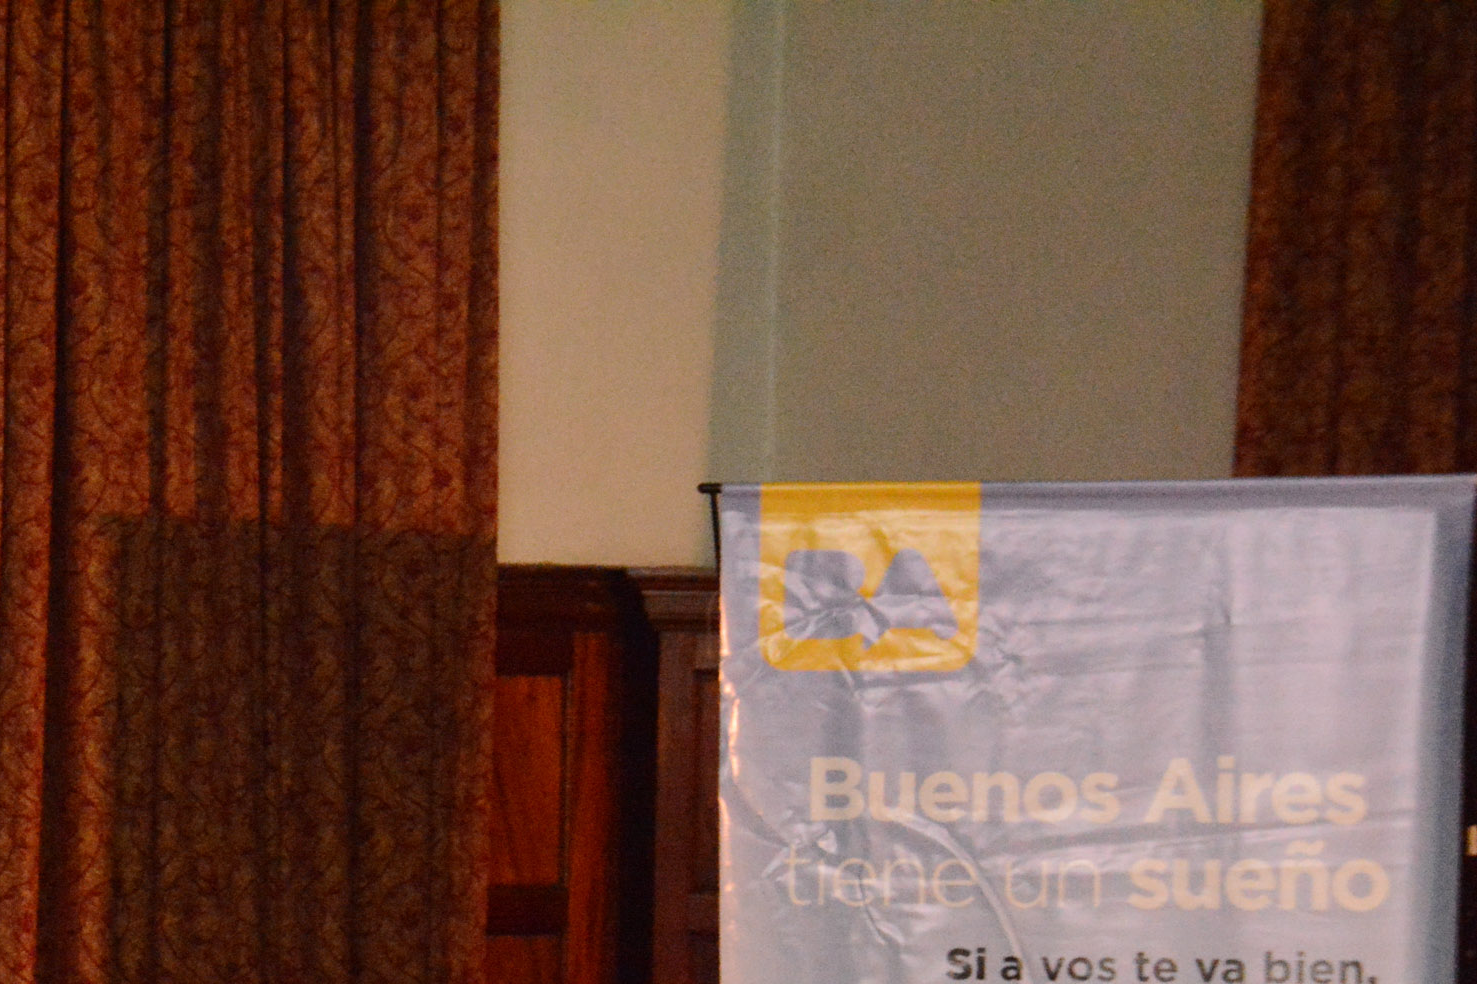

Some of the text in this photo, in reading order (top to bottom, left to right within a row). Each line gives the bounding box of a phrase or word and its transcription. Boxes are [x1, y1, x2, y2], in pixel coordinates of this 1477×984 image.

[810, 756, 1368, 826] Buenos Aires
[784, 840, 1390, 915] tiene un sueño
[946, 947, 986, 981] Si
[1001, 955, 1023, 981] a
[1043, 955, 1116, 982] vos
[1135, 951, 1178, 982] te
[1195, 956, 1246, 984] va
